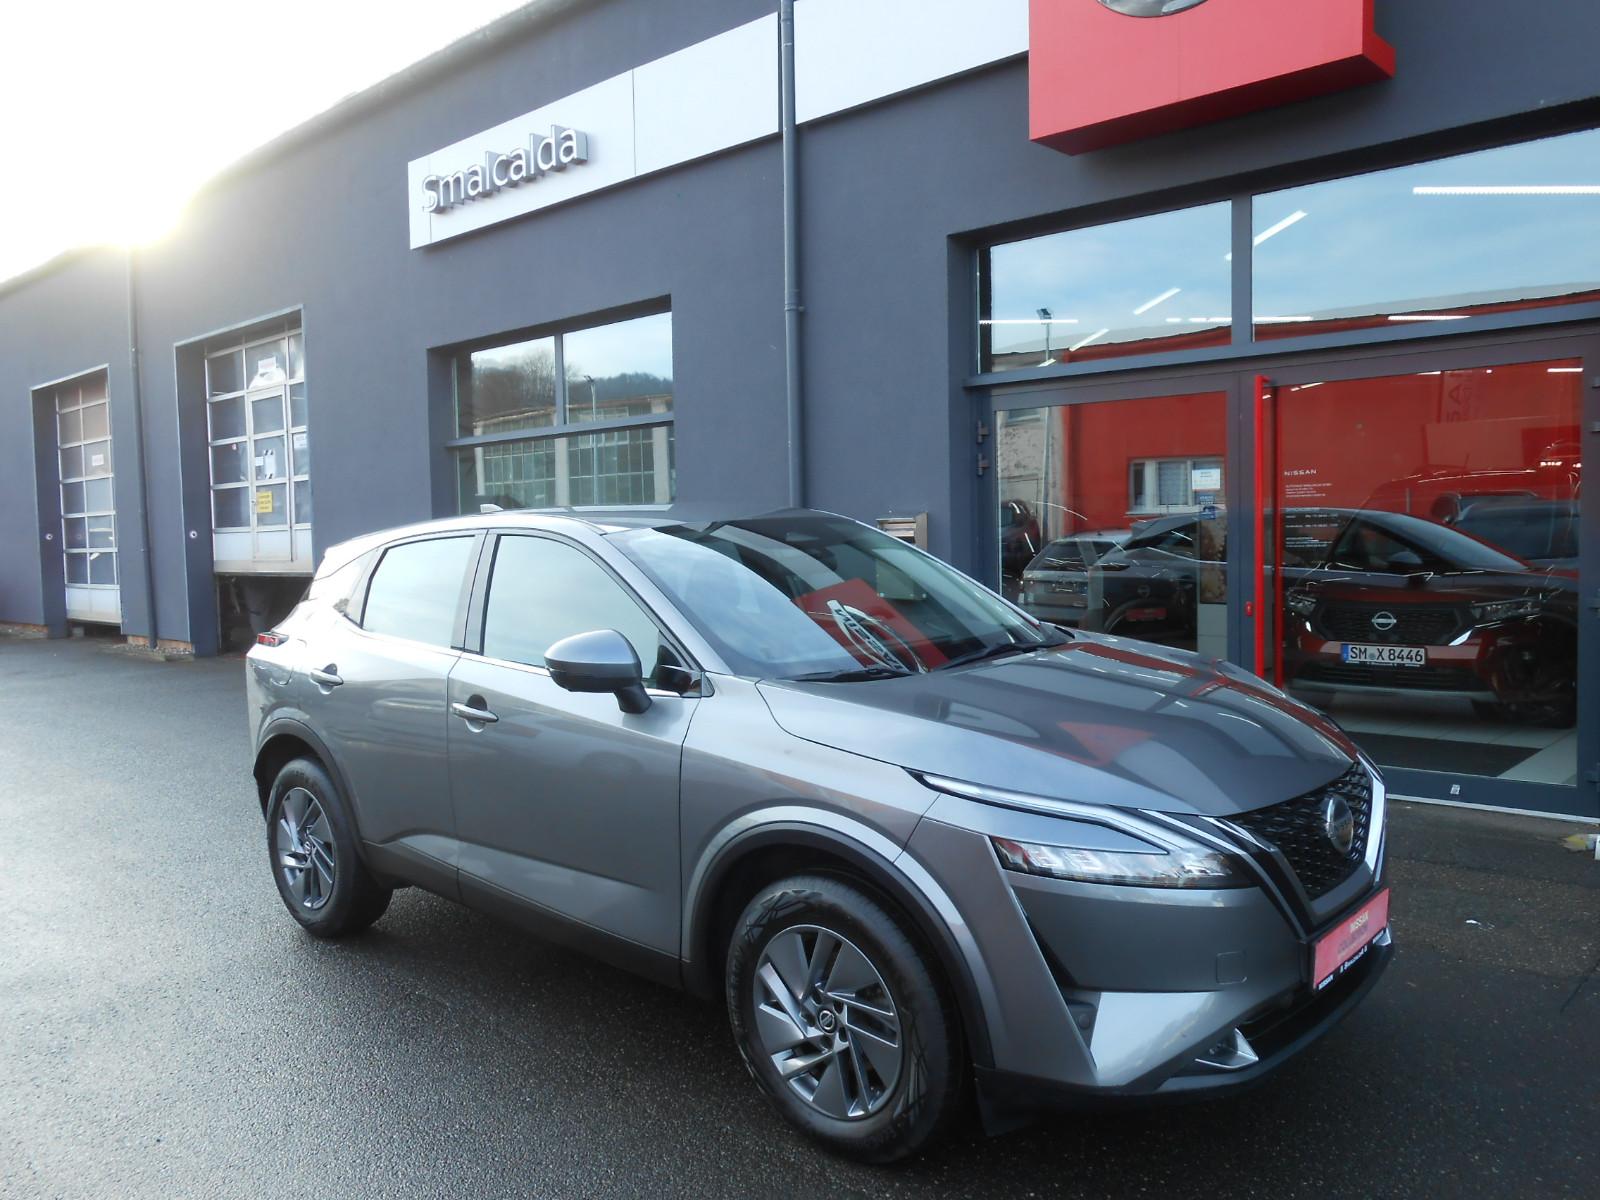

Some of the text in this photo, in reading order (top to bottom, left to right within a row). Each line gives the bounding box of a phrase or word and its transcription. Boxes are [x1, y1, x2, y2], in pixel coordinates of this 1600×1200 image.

[422, 125, 587, 213] Smalcalda
[1350, 647, 1423, 662] SM X 8446
